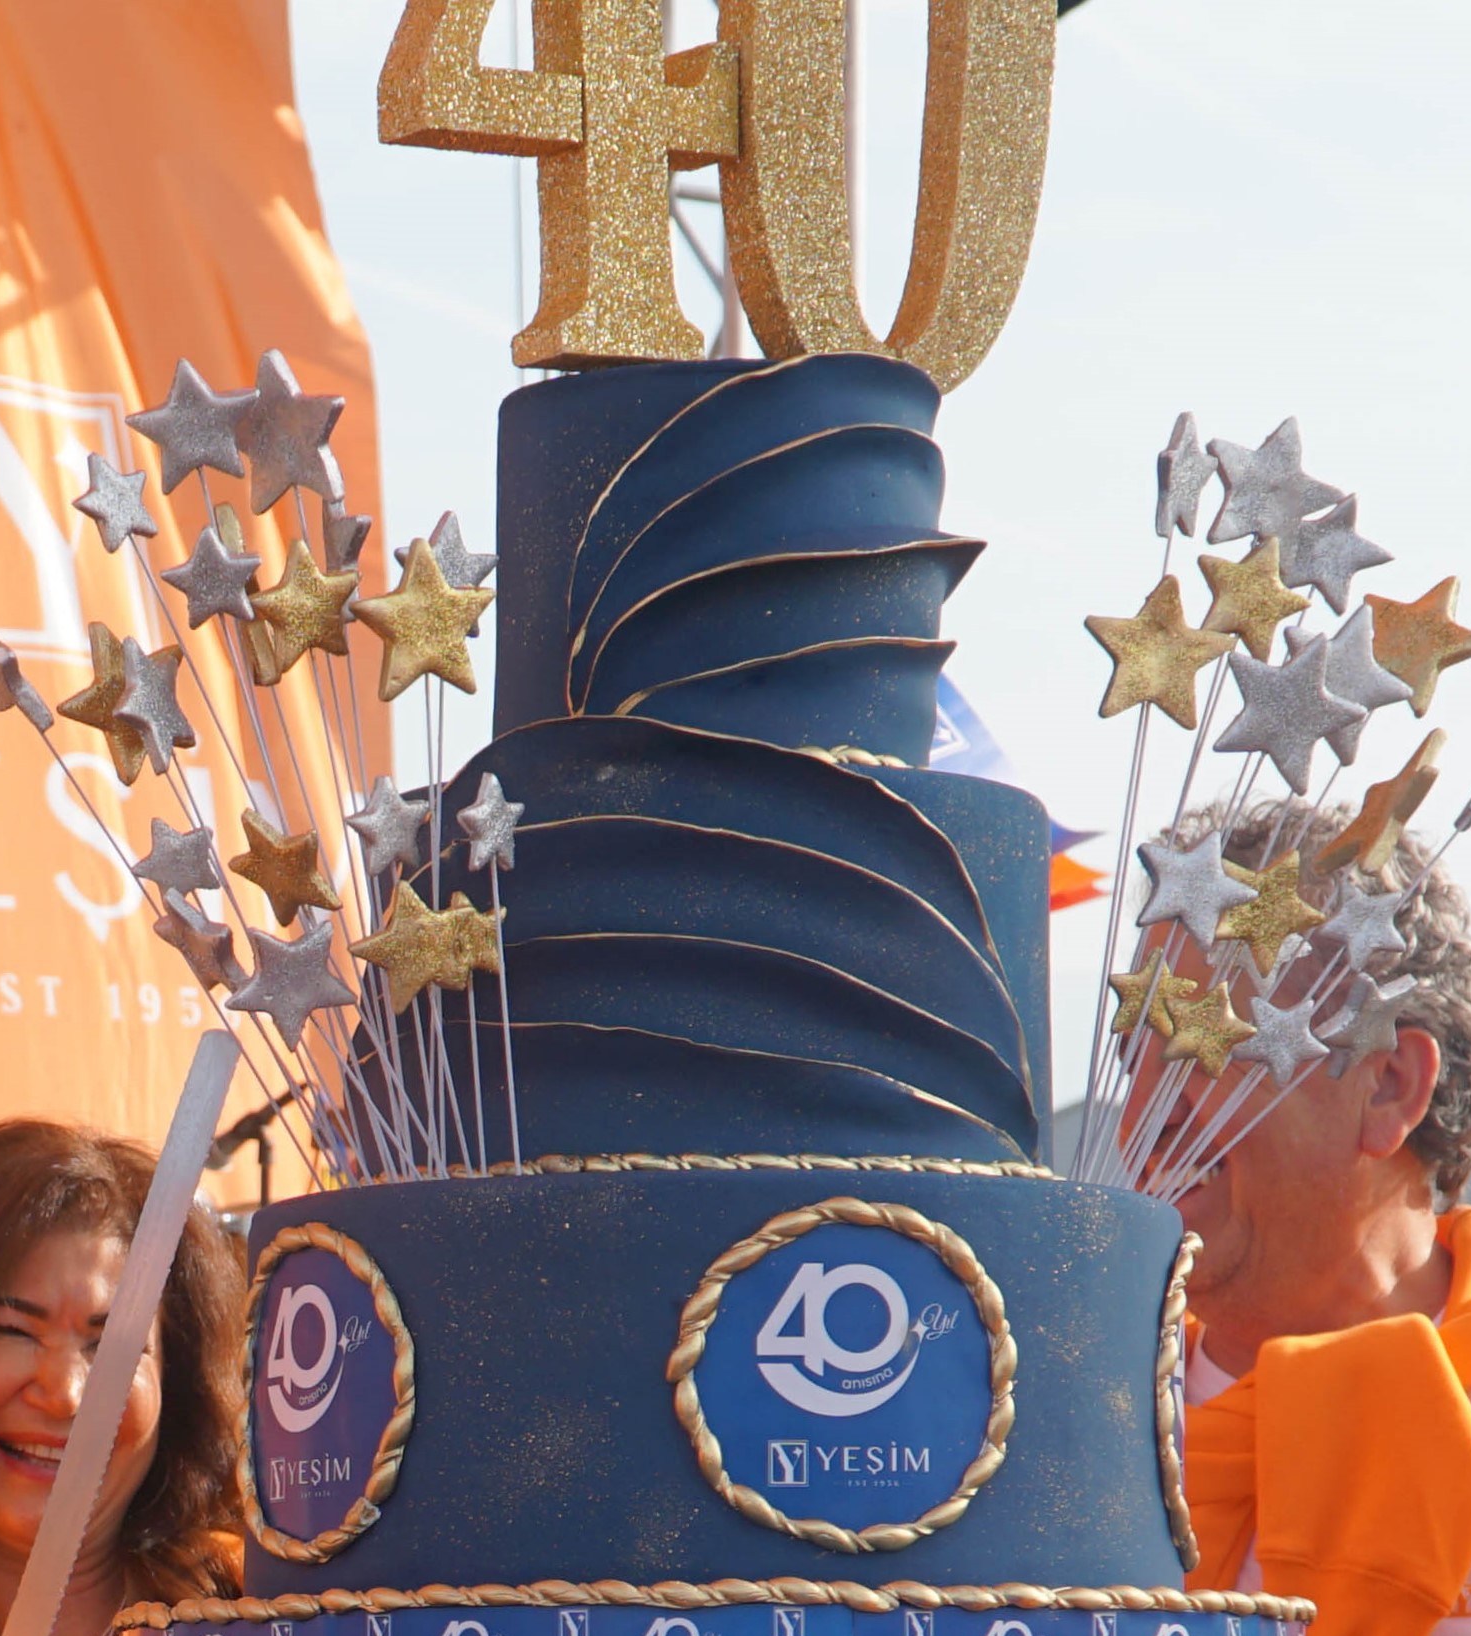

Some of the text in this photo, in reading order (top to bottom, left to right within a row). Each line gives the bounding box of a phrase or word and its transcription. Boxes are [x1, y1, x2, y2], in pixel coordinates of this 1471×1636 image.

[378, 0, 1057, 397] 40
[268, 1284, 338, 1396] 40
[756, 1263, 910, 1377] 40
[841, 1367, 894, 1391] anısına
[288, 1453, 352, 1487] YEŞİM
[816, 1441, 931, 1475] YEŞİM
